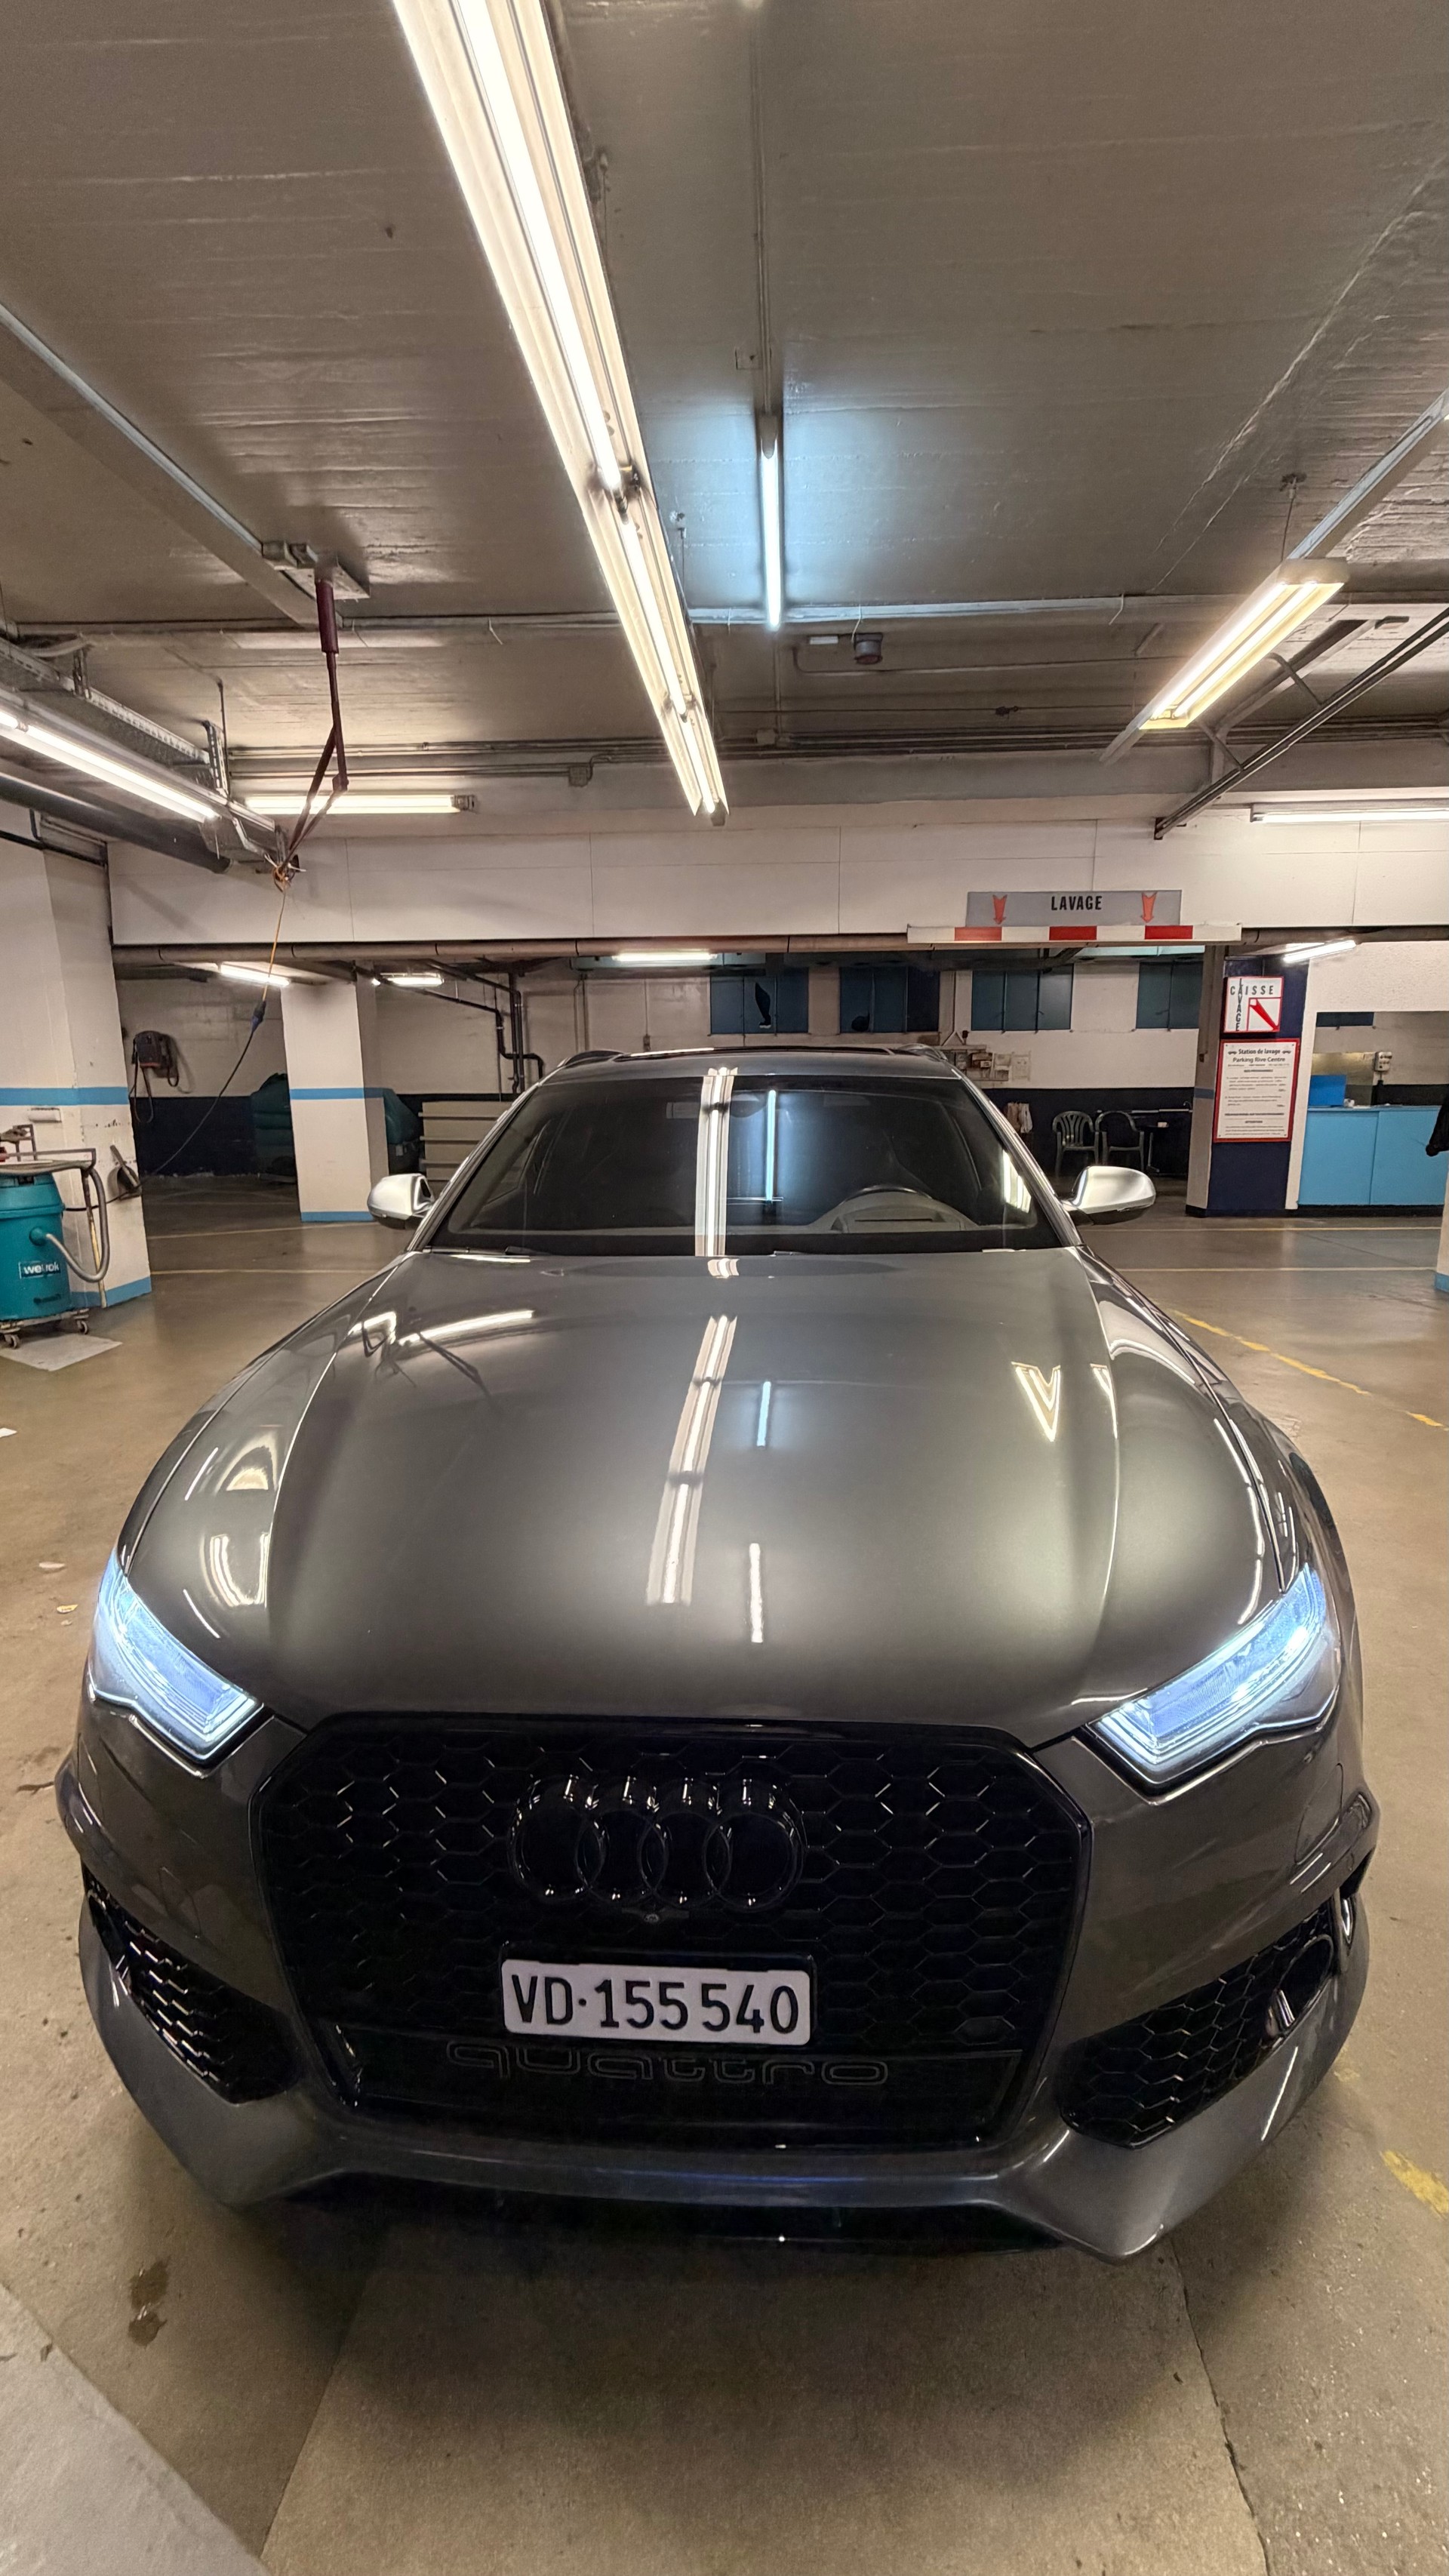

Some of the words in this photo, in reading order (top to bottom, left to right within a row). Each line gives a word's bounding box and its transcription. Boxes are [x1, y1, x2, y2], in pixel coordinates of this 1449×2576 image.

[1051, 895, 1103, 911] LAVAGE
[1230, 985, 1274, 996] CAISSE
[447, 2040, 888, 2085] quattro
